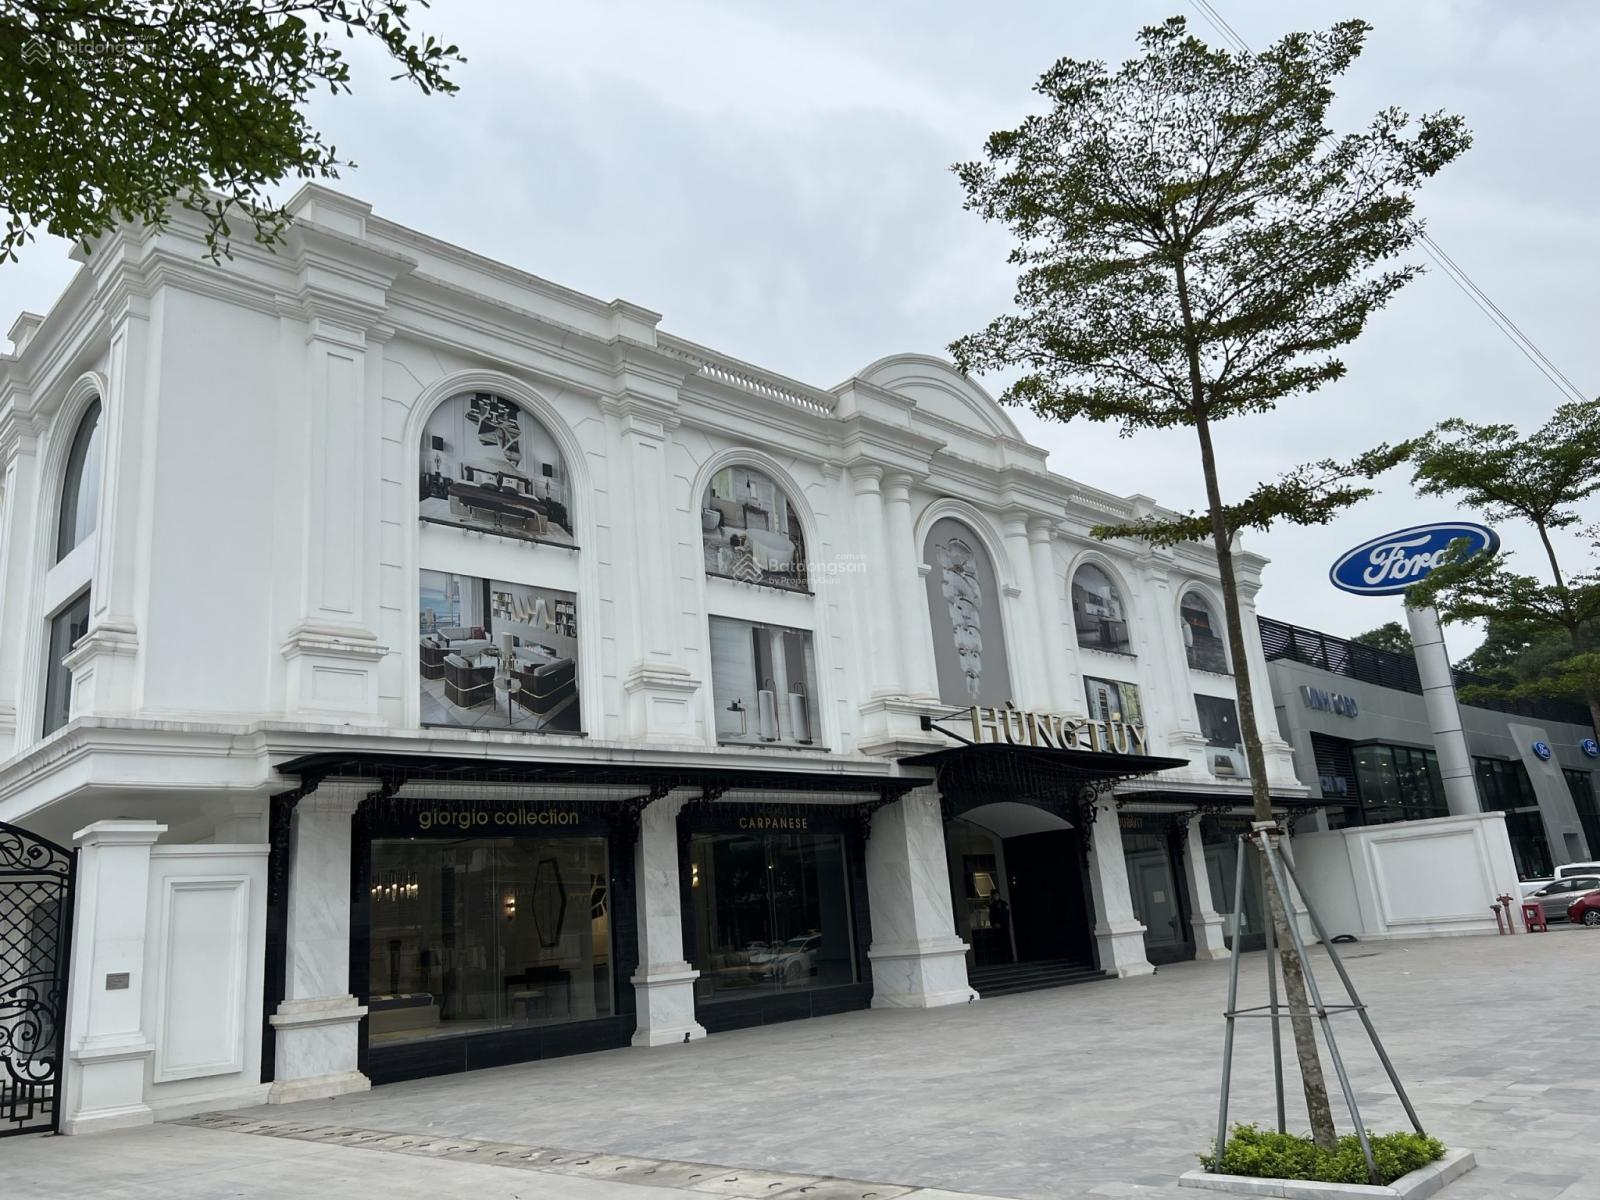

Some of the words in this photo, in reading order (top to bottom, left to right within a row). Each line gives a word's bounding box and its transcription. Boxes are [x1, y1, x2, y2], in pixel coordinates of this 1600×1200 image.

[969, 701, 1081, 751] HÙNG
[418, 808, 488, 829] giorgio
[494, 808, 579, 825] collection
[739, 817, 808, 829] CARPANESE
